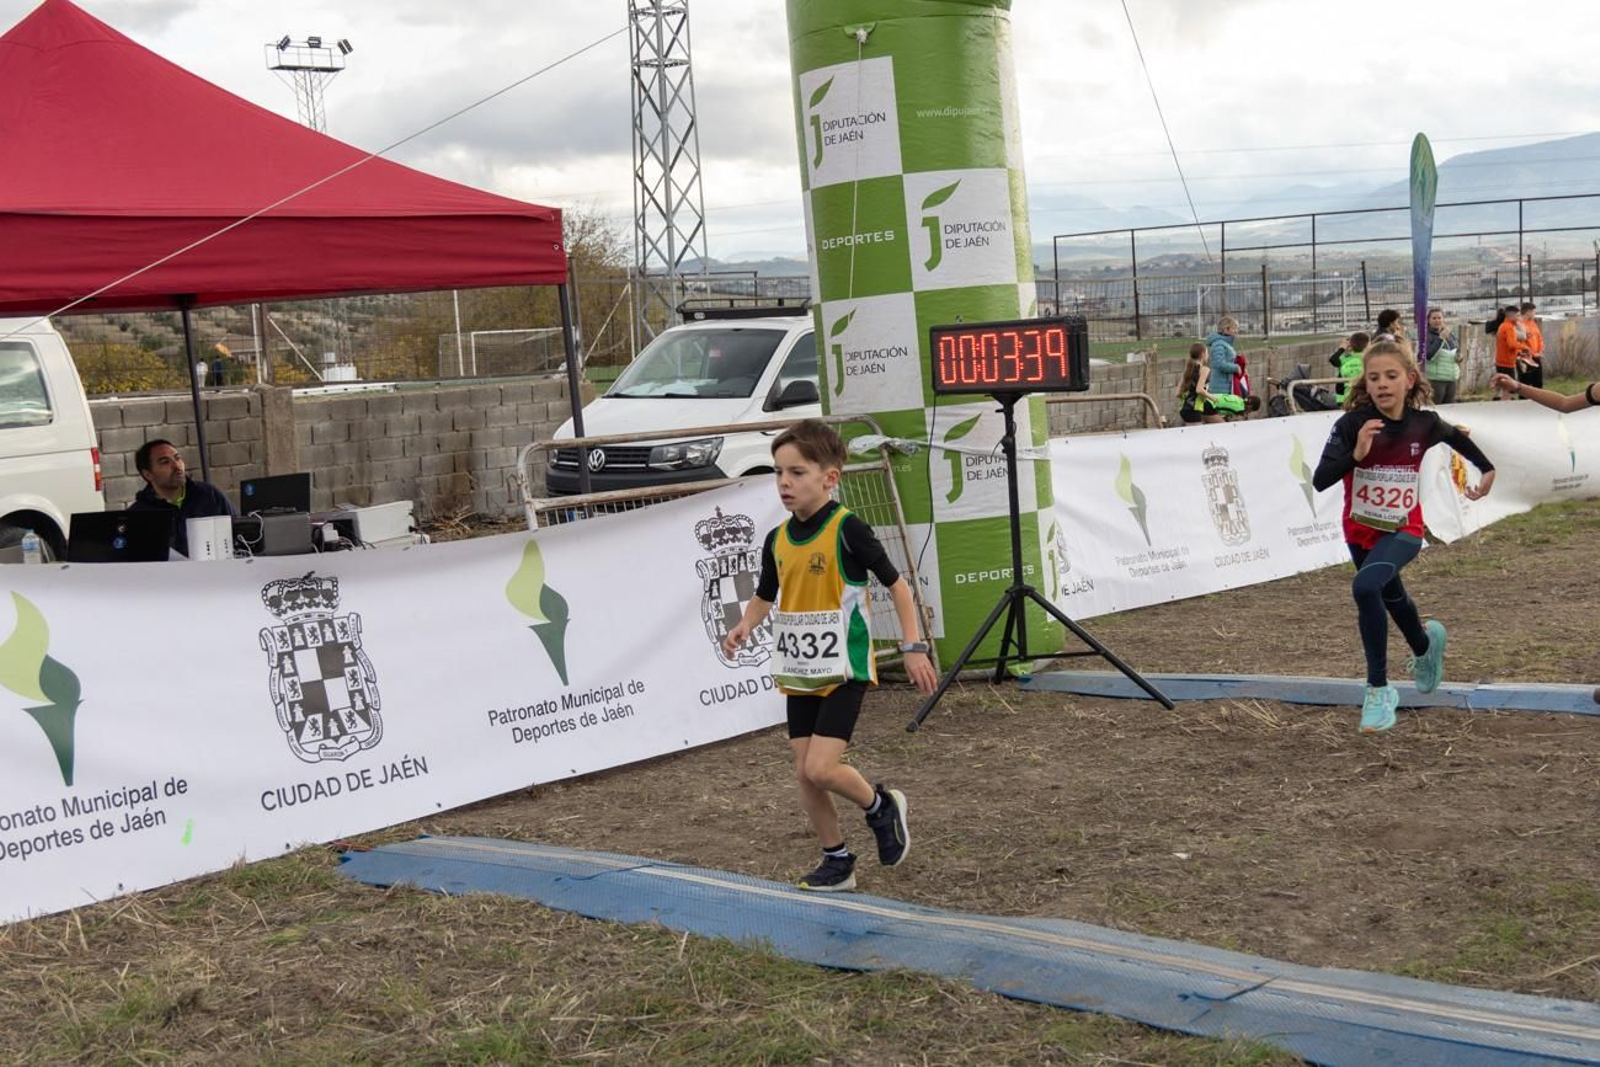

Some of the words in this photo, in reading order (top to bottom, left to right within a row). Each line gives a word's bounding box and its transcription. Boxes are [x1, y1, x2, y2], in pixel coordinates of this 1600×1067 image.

[822, 111, 887, 133] DIPUTACIÓN
[824, 134, 838, 146] DE
[838, 129, 864, 144] JAÉN
[944, 220, 1006, 235] DIPUTACIÓN
[822, 230, 895, 250] DEPORTES
[945, 237, 959, 249] DE
[959, 235, 990, 249] JAÉN
[845, 345, 908, 361] DIPUTACIÓN
[846, 365, 859, 376] DE
[859, 361, 886, 375] JAÉN
[965, 454, 1007, 467] DIPUTA
[967, 470, 983, 481] DE
[1356, 485, 1414, 509] 4326
[1071, 578, 1095, 595] JAÉN
[777, 631, 839, 659] 4332
[488, 699, 558, 726] Patronato
[561, 682, 625, 711] Municipal
[627, 679, 645, 695] de
[700, 679, 758, 706] CIUDAD
[512, 717, 577, 744] Deportes
[580, 712, 598, 728] de
[601, 702, 634, 722] Jaén
[261, 776, 342, 811] CIUDAD
[345, 768, 374, 792] DE
[379, 754, 429, 785] JAÉN
[61, 780, 158, 818] Municipal
[164, 777, 188, 797] de
[89, 819, 114, 840] de
[121, 807, 166, 833] Jaén
